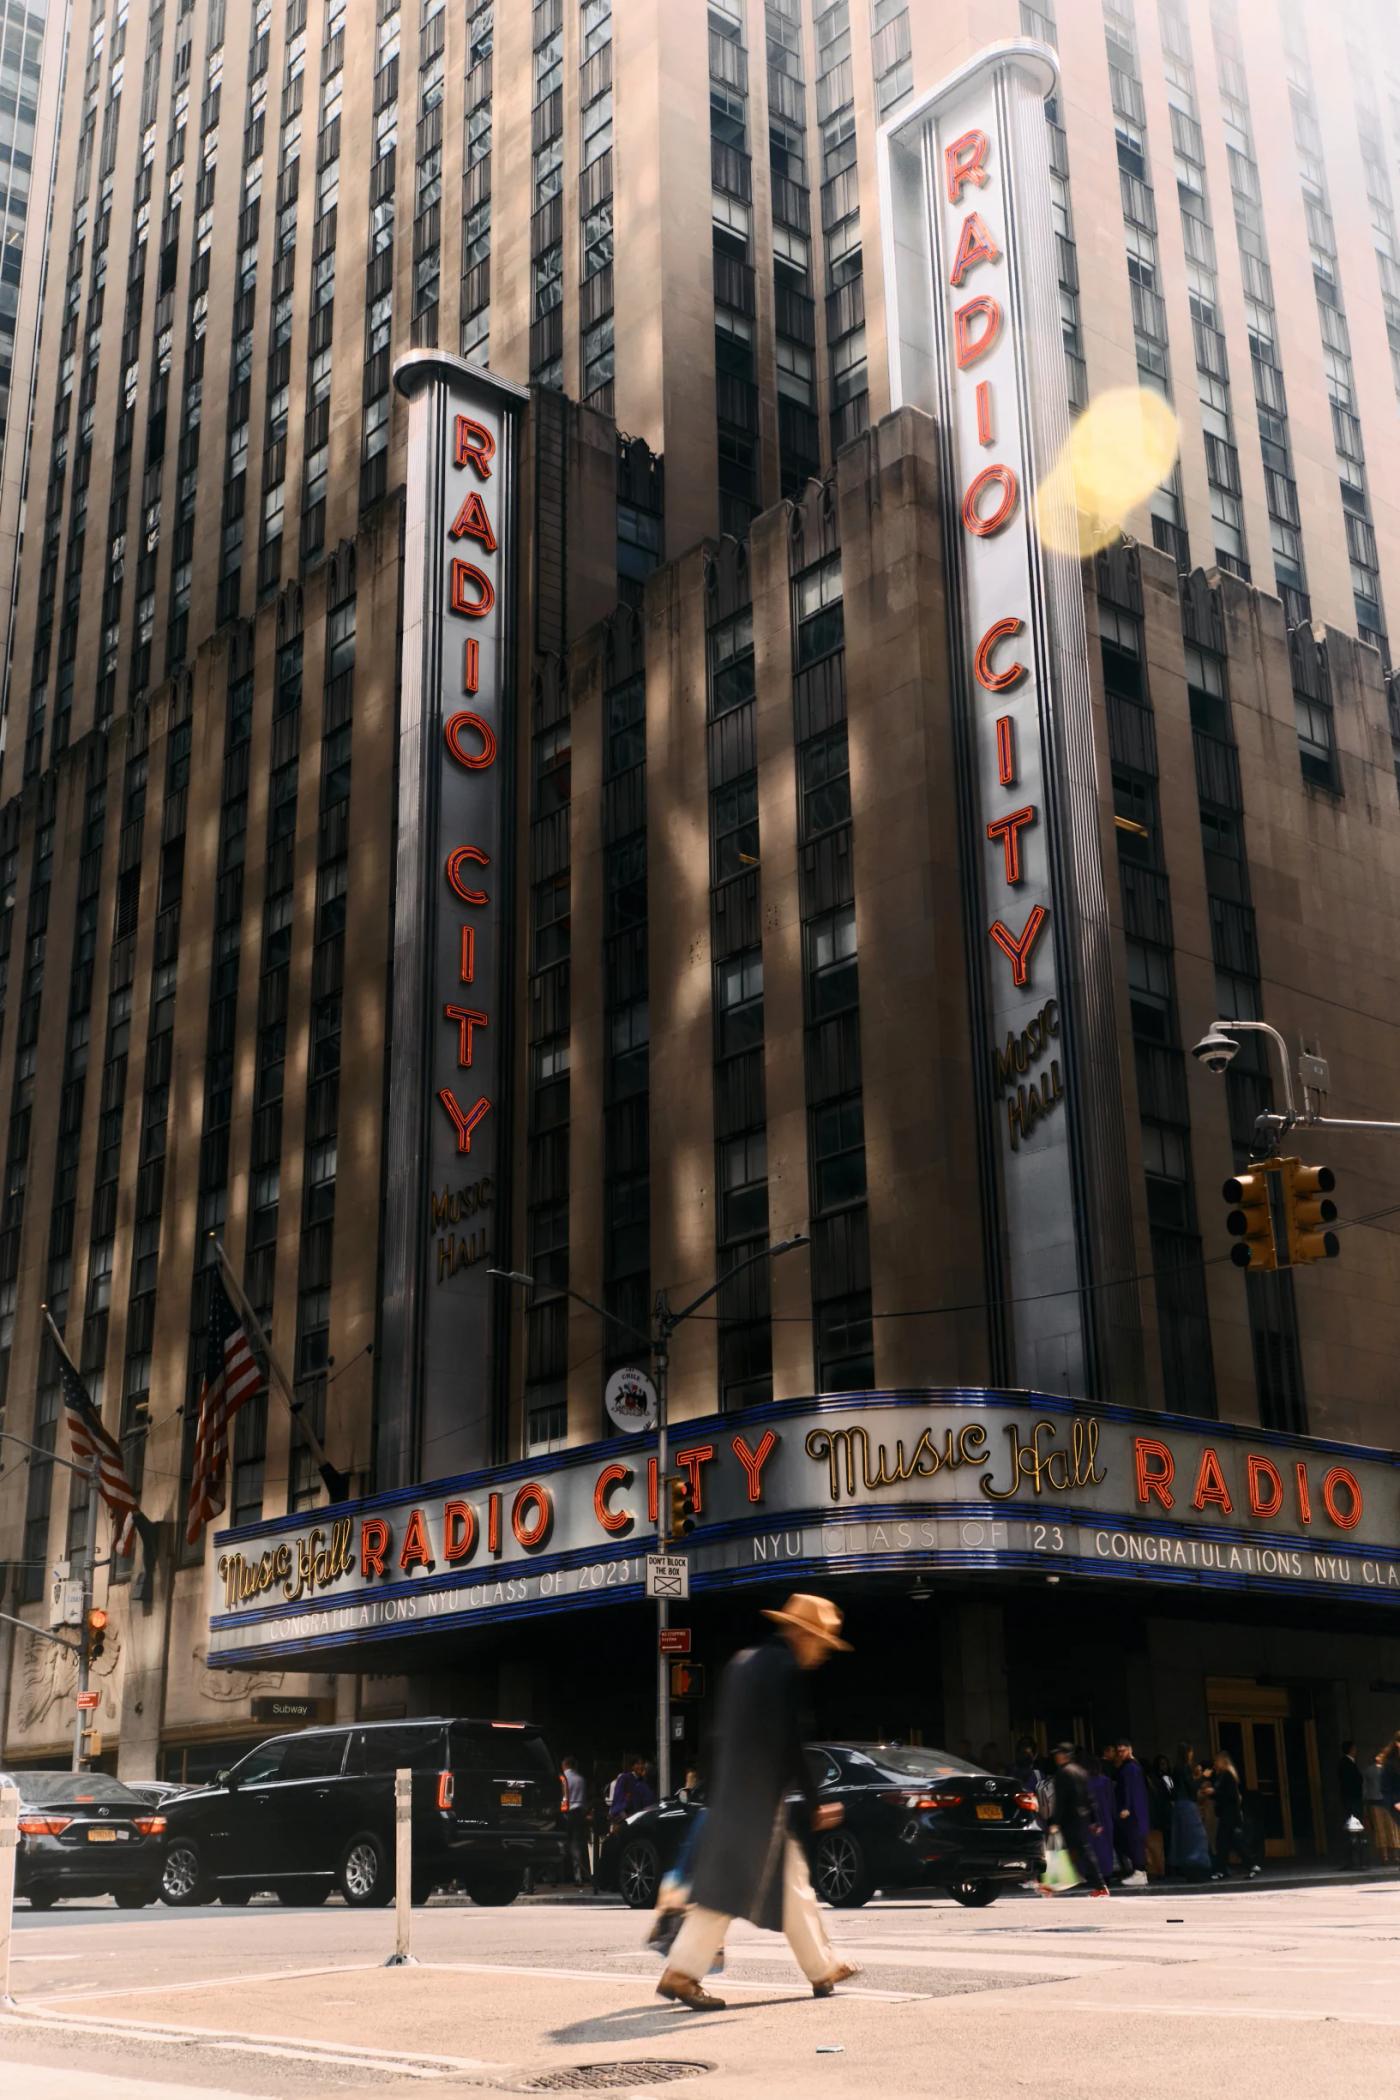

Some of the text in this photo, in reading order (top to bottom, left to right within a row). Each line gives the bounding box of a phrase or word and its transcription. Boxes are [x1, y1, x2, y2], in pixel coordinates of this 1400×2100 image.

[945, 128, 1050, 987] RADIO CITY
[439, 414, 497, 1153] RADIO CITY
[805, 1417, 1107, 1500] Music Hall
[1135, 1437, 1364, 1530] RADIO
[361, 1429, 777, 1578] RADIO CITY
[753, 1532, 801, 1561] NYU
[823, 1522, 936, 1553] CLASS
[962, 1521, 1004, 1547] OF
[217, 1516, 355, 1612] Music Hall
[270, 1558, 641, 1640] CONGRATULATIONS NYU CLASS OF 2023!
[649, 1556, 686, 1567] DON'T BLOCK
[655, 1566, 680, 1576] THE BOX
[1095, 1531, 1400, 1586] CONGRATULATIONS NYU CLA
[272, 1703, 308, 1715] Subway
